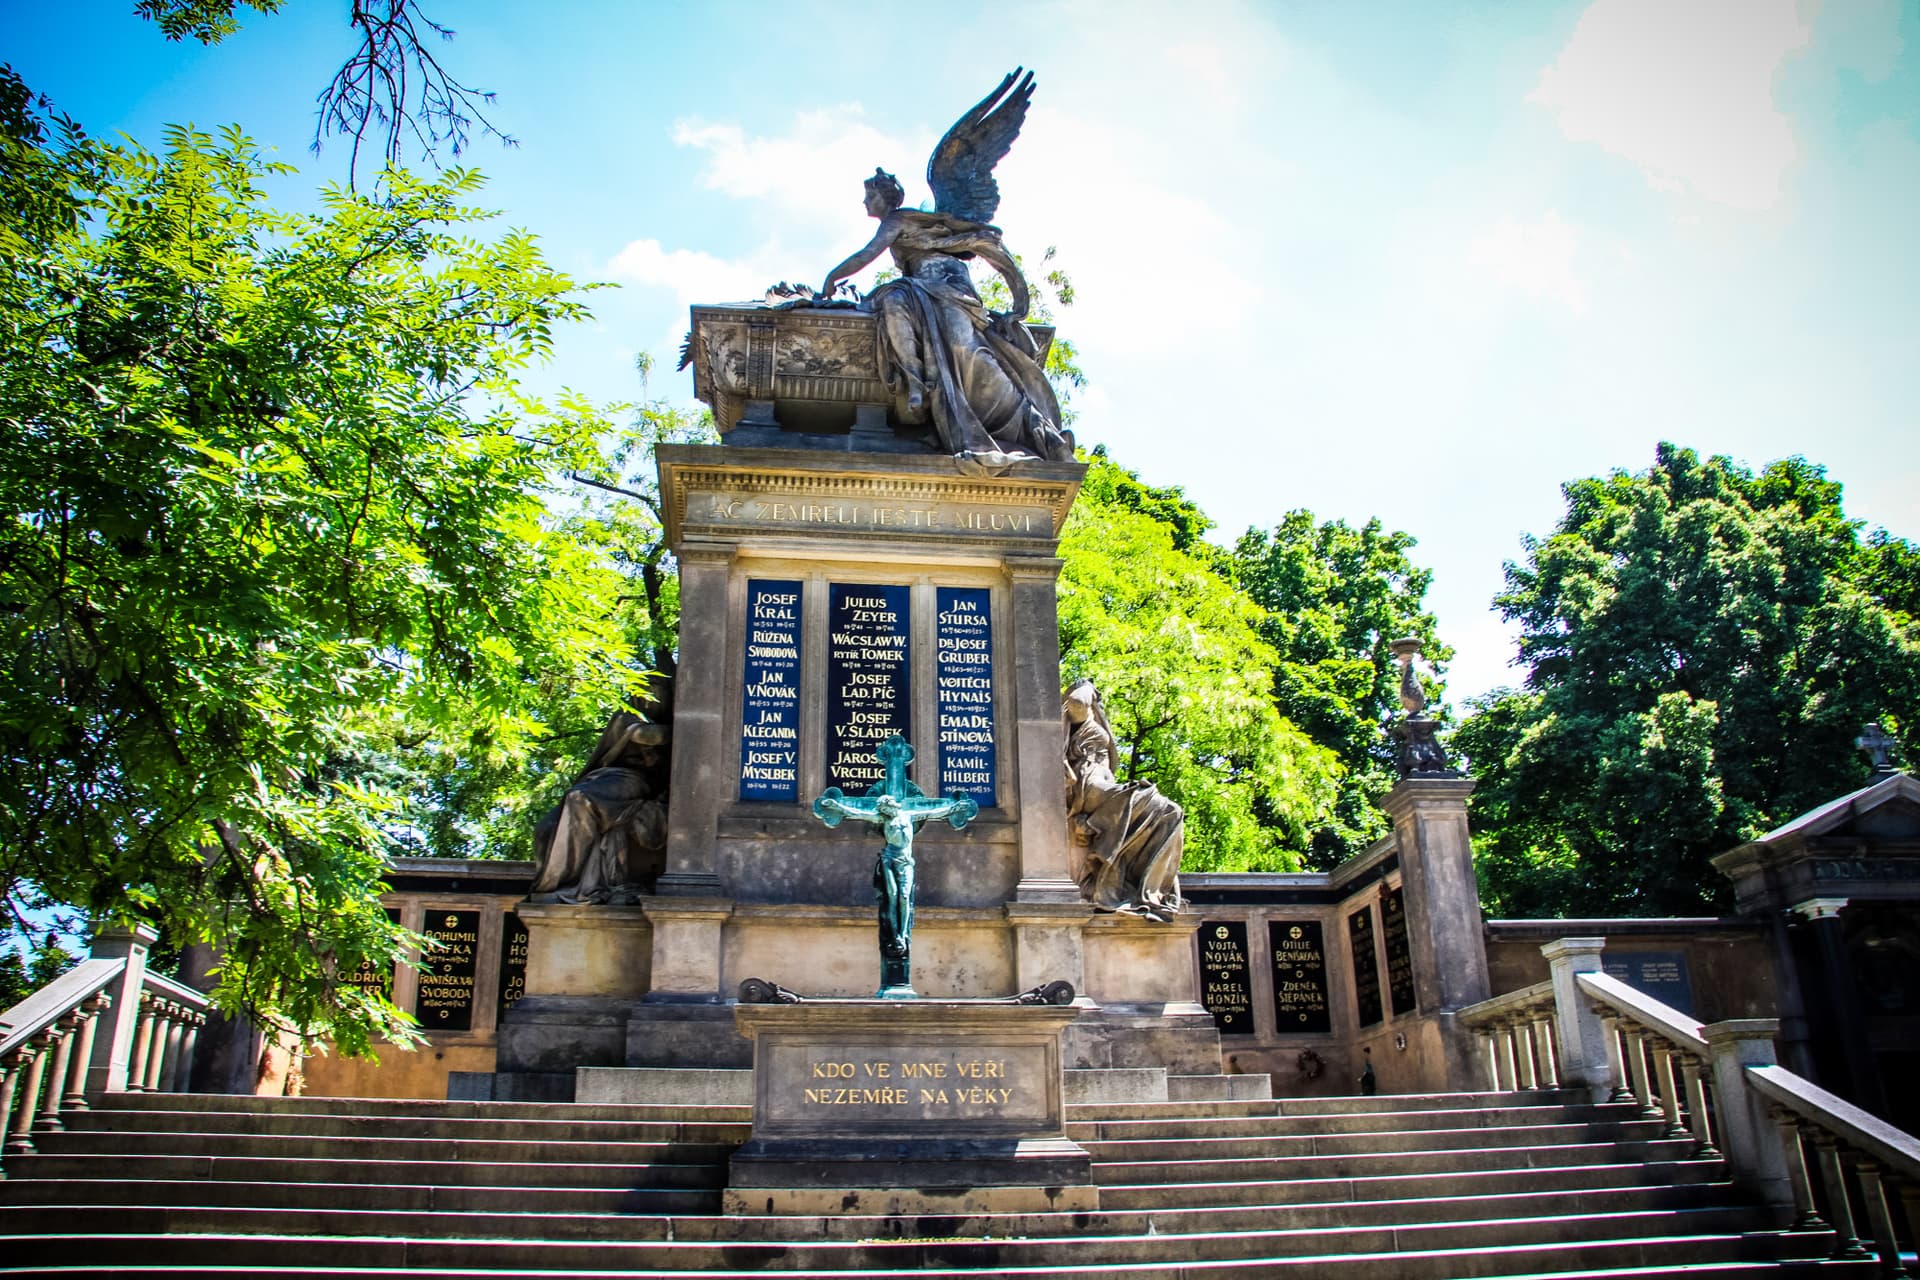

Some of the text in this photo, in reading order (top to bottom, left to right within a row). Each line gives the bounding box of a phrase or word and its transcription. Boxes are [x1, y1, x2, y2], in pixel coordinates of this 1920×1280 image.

[753, 592, 797, 605] JOSEF
[841, 596, 887, 610] JULIUS
[754, 606, 796, 619] KRÁL
[952, 600, 977, 613] JAN
[853, 610, 897, 622] ZEYER
[832, 631, 907, 647] WÁCSLAW W.
[954, 638, 988, 651] JOSEF
[748, 645, 798, 659] SVOBODOVÁ
[860, 648, 904, 661] TOMEK
[938, 651, 990, 664] GRUBER
[758, 670, 783, 685] JAN
[847, 672, 891, 686] JOSEF
[757, 710, 782, 725] JAN
[847, 712, 892, 725] JOSEF
[940, 714, 970, 728] EMA
[743, 725, 797, 739] KLECANDA
[835, 725, 903, 739] V. SLÁDEK
[745, 751, 796, 766] JOSEF V.
[833, 751, 879, 765] JAROS
[742, 766, 796, 780] MYSLBEK
[830, 766, 887, 779] VRCHLIC
[943, 770, 991, 783] HILBERT
[1208, 941, 1237, 950] VOJTA
[1205, 950, 1244, 962] NOVÁK
[420, 986, 471, 998] SVOBODA
[1208, 982, 1244, 993] KAREL
[813, 1062, 856, 1078] KDO
[864, 1062, 891, 1078] VE
[901, 1062, 948, 1078] MNE
[804, 1085, 1013, 1105] NEZEMŘE NA VĚKY
